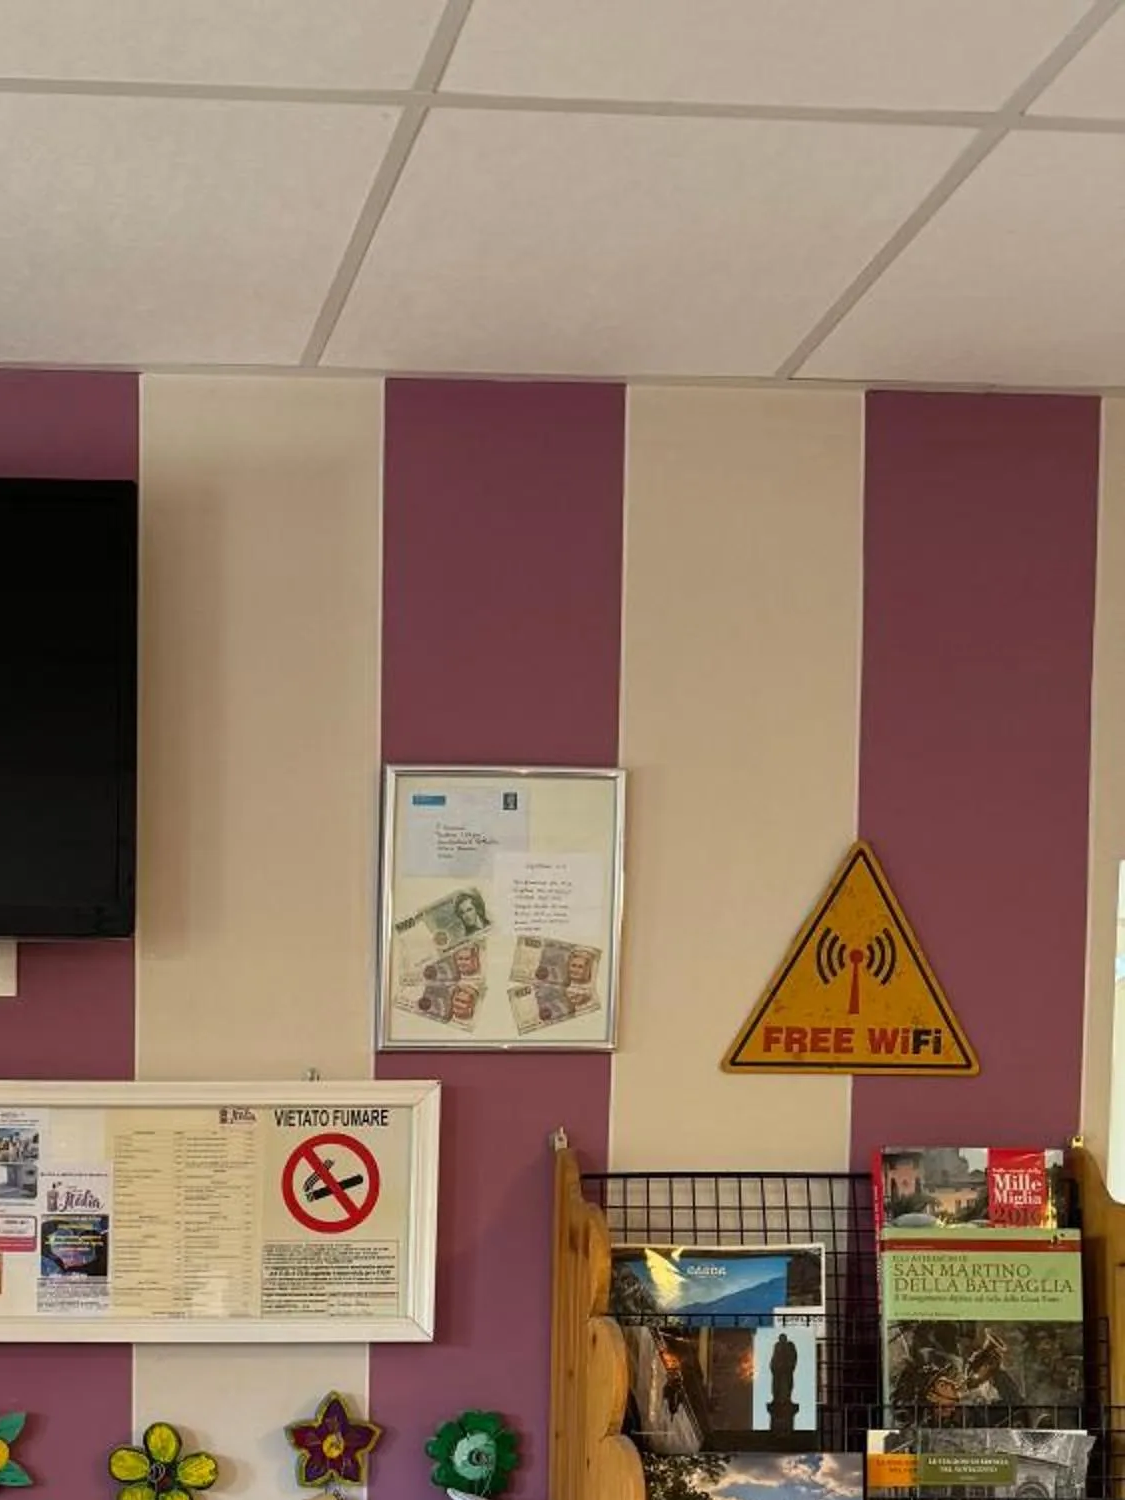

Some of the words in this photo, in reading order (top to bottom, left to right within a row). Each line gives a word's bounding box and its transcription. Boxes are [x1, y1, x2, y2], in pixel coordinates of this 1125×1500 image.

[763, 1026, 854, 1054] FREE
[868, 1027, 942, 1055] WiFi
[274, 1109, 328, 1127] VIETATO
[332, 1109, 388, 1127] FUMARE
[993, 1173, 1043, 1191] Mille
[993, 1189, 1043, 1207] Miglia
[893, 1263, 935, 1278] SAN
[939, 1263, 1032, 1278] MARTINO
[894, 1279, 961, 1293] DELLA
[965, 1279, 1074, 1294] BATTAGLIA
